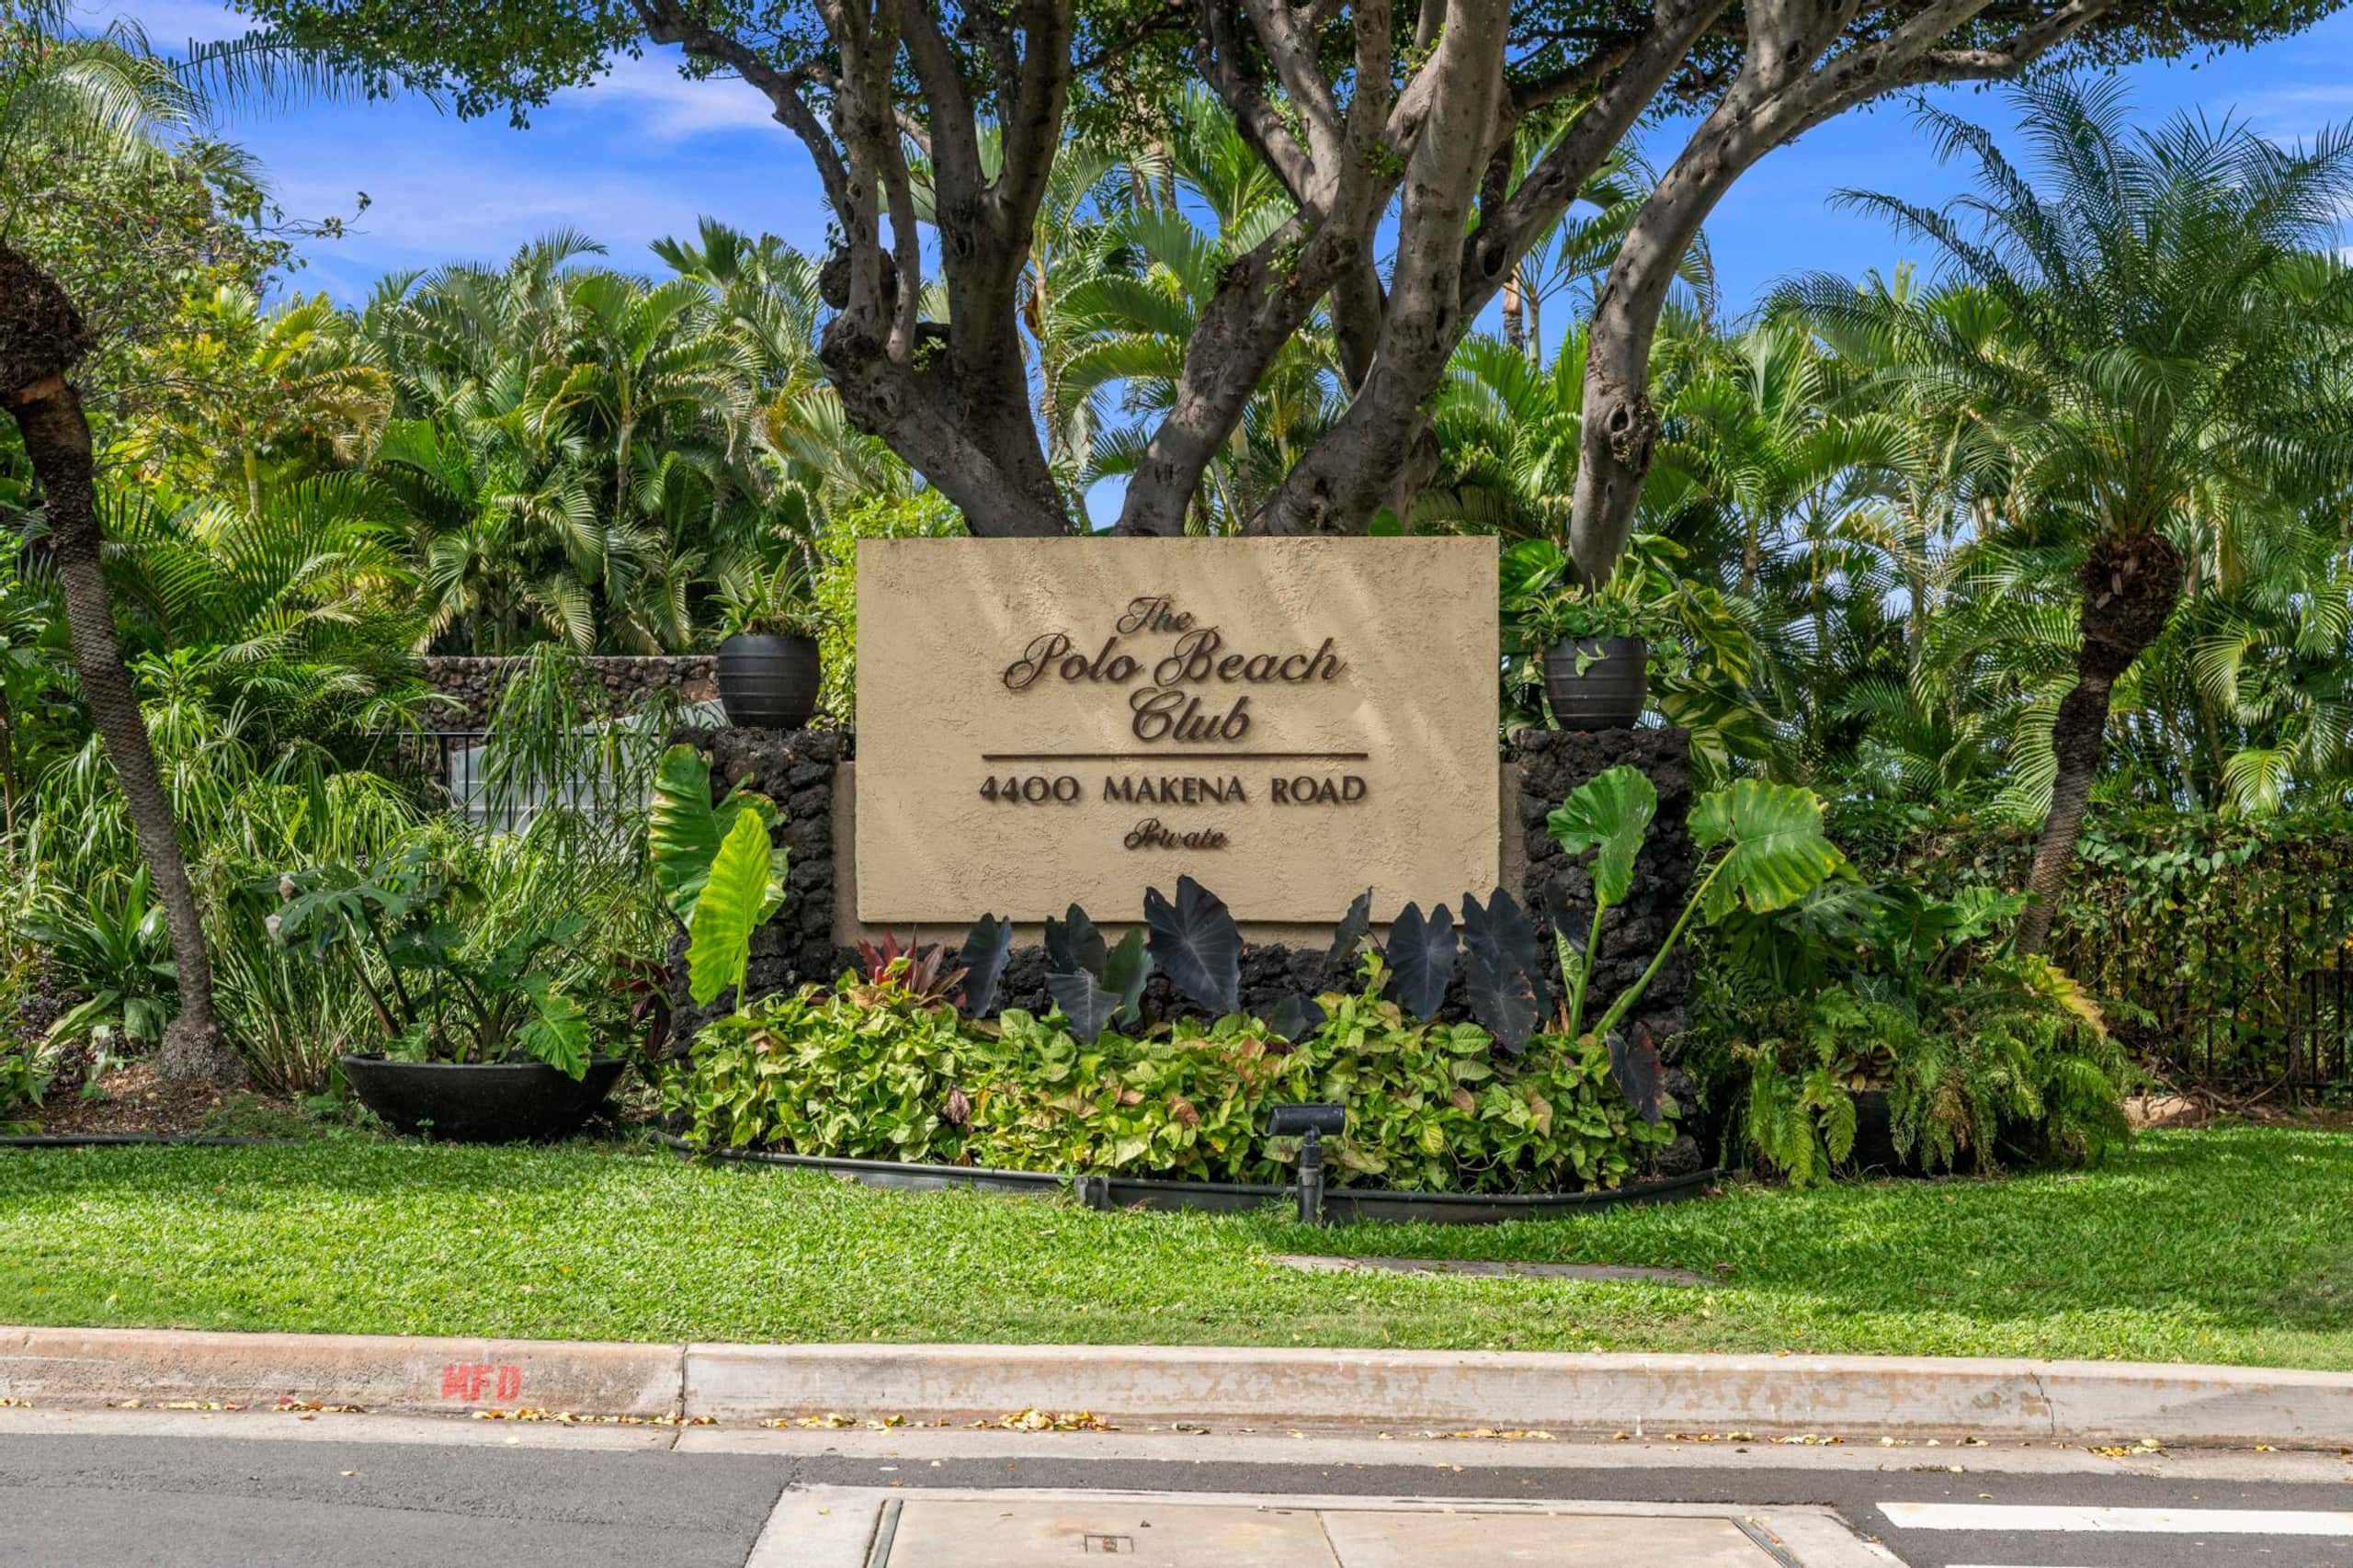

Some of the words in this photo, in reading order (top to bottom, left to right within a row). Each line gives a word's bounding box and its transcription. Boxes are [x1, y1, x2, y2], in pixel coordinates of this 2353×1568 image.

[1116, 594, 1194, 634] The
[1004, 631, 1143, 689] Polo
[1154, 626, 1347, 687] Beach
[1130, 687, 1251, 743] Club
[979, 775, 1081, 805] 4400
[1103, 775, 1246, 804] MAKENA
[1271, 775, 1367, 804] ROAD
[1124, 817, 1229, 849] Private
[442, 1362, 521, 1402] MFD
